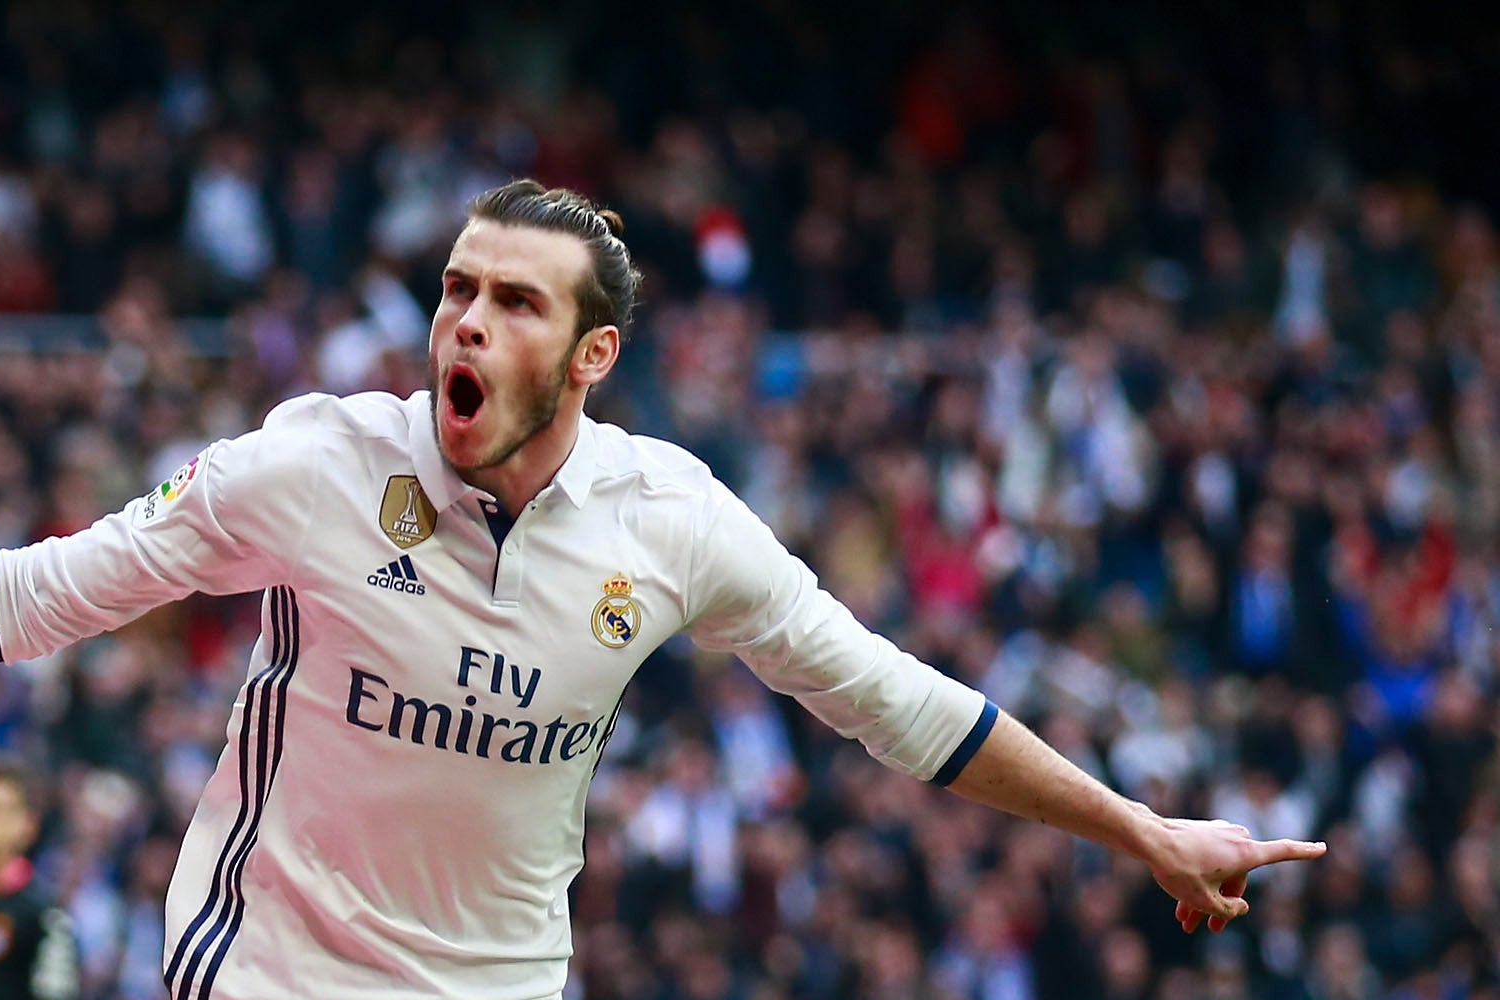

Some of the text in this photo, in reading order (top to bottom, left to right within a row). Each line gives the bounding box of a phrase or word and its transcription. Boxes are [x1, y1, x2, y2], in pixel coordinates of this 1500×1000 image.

[393, 521, 420, 534] FIFA
[367, 575, 426, 596] adidas
[457, 646, 542, 708] Fly
[346, 667, 605, 765] Emirates
